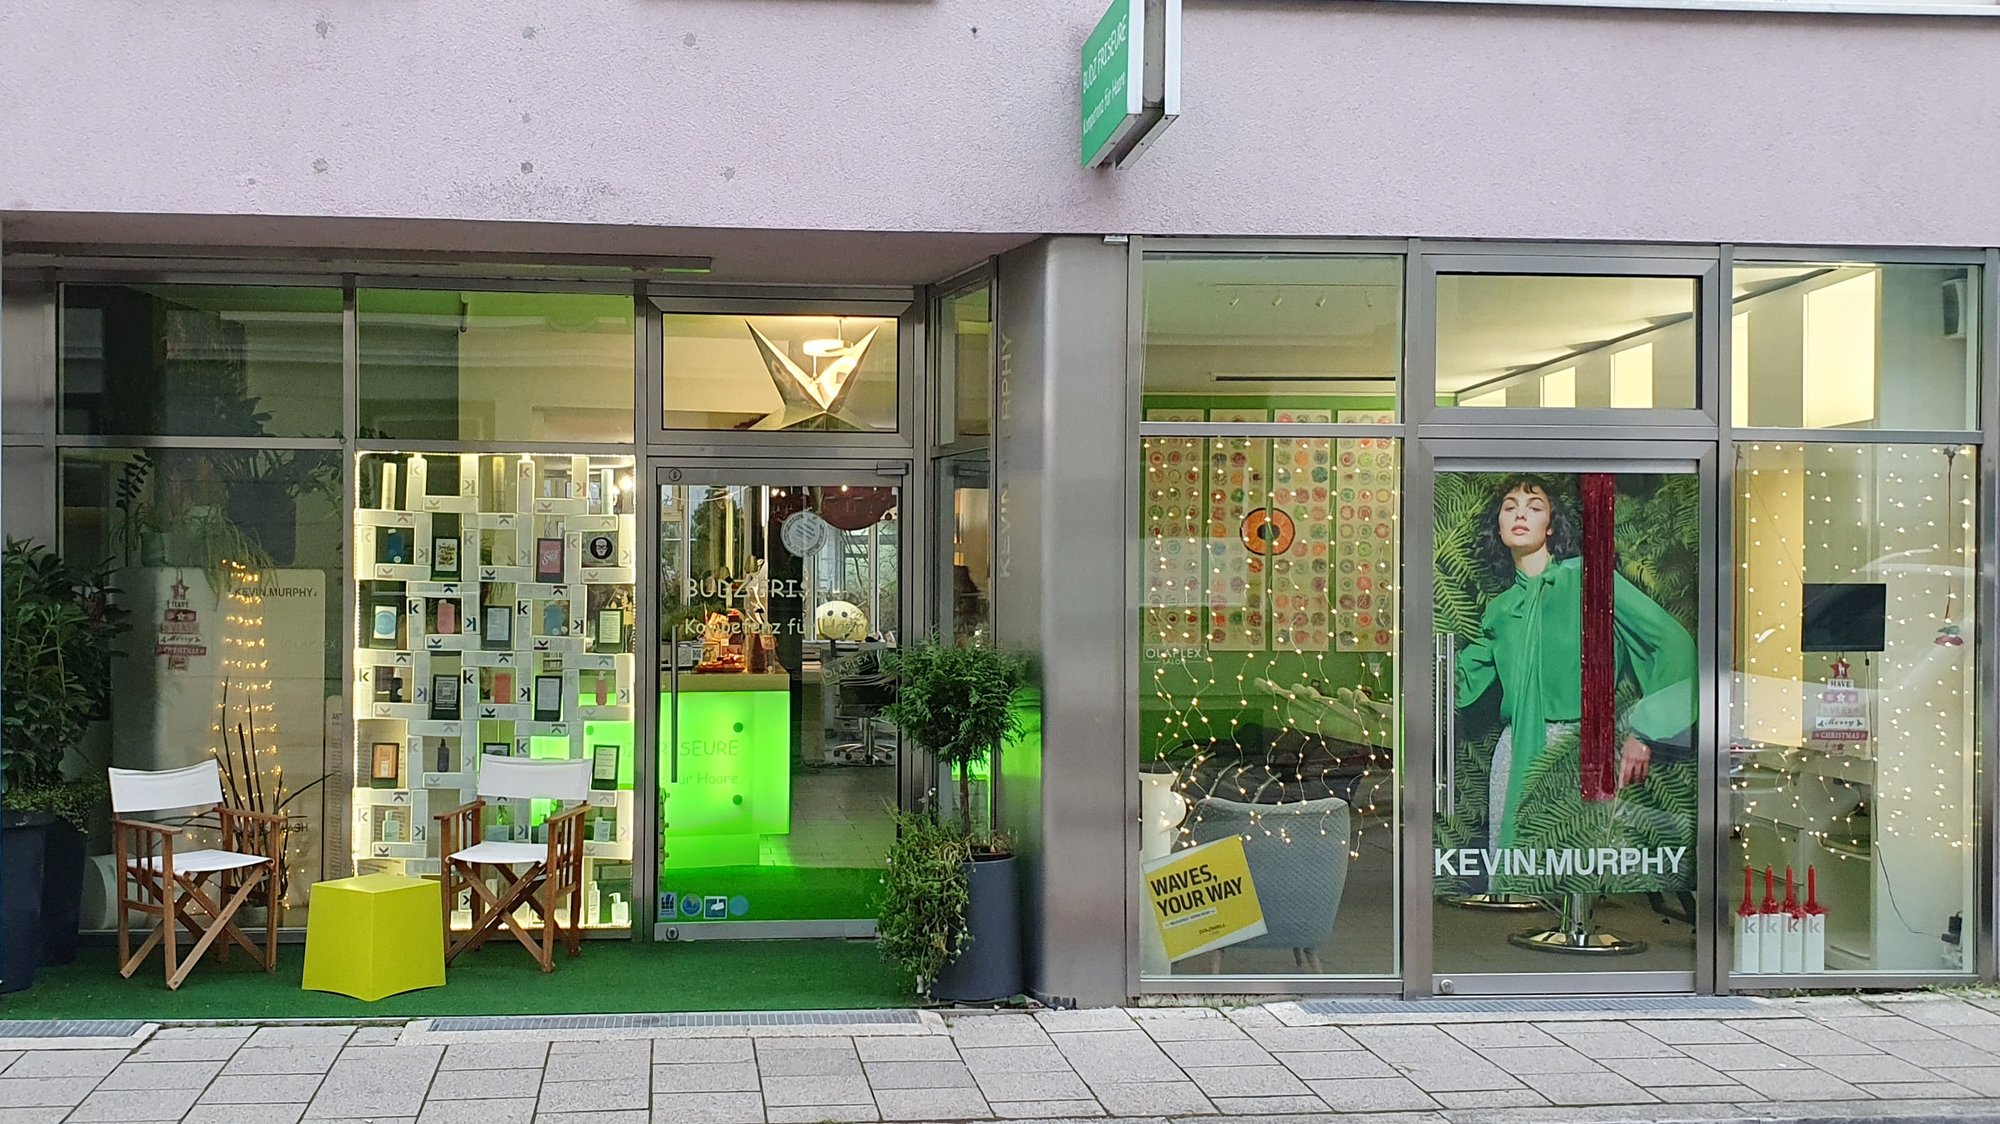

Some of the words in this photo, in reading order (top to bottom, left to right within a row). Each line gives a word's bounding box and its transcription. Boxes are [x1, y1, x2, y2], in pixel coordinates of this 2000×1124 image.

[1083, 56, 1097, 94] BUDZ
[1097, 14, 1127, 75] FRISEURE
[686, 578, 749, 600] BUDZ
[824, 652, 870, 679] OLAPLEX
[1145, 648, 1202, 659] OLAPLEX
[1831, 680, 1852, 688] HAVE
[1825, 718, 1855, 727] Merry
[1821, 731, 1860, 739] CHRISTMAS
[1435, 846, 1687, 877] KEVIN.MURPHY
[1151, 864, 1218, 897] WAVES,
[1156, 891, 1205, 917] YOUR
[1205, 877, 1244, 903] WAY
